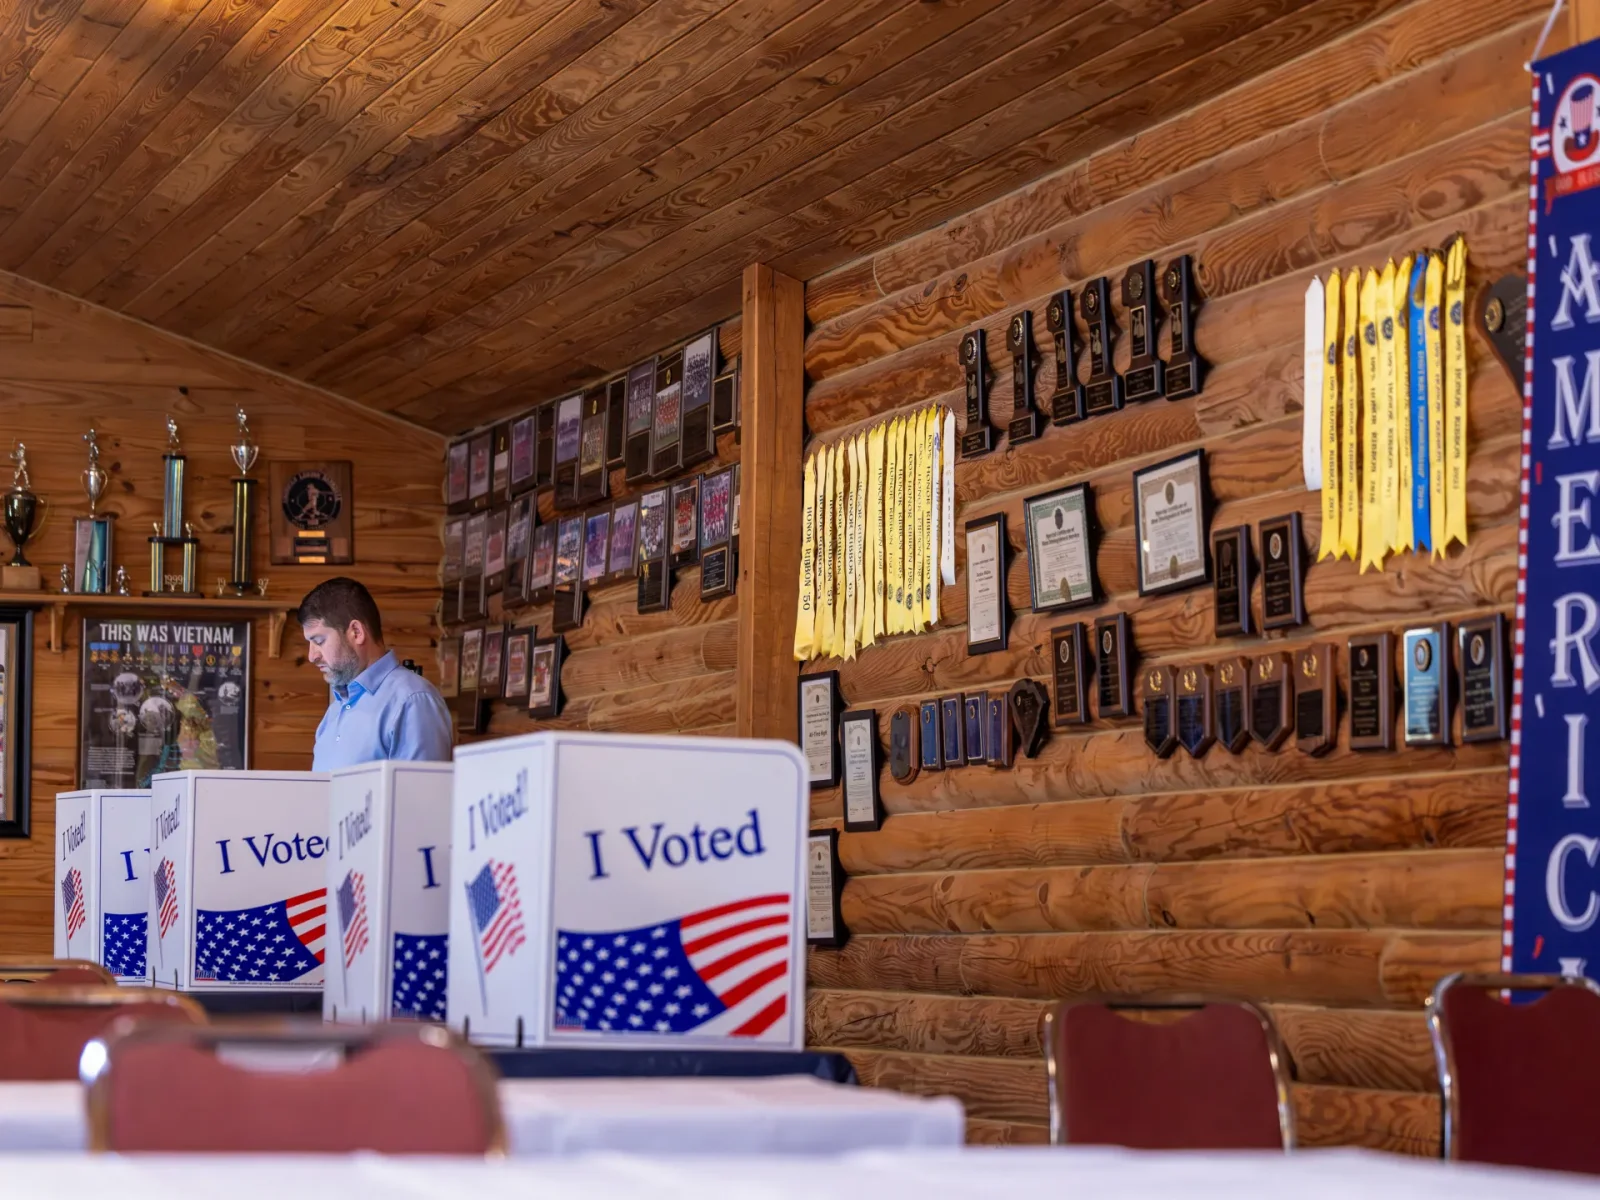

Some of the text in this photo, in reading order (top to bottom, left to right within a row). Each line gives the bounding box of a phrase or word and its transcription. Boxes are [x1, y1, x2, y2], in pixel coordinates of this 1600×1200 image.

[164, 574, 182, 585] 1999
[1546, 233, 1600, 977] AMERIC
[100, 623, 234, 644] THIS WAS VIETNAM
[66, 810, 86, 852] Voted!
[160, 793, 181, 841] Voted!
[344, 790, 372, 849] Voted!
[468, 768, 529, 851] I Voted!
[120, 849, 139, 882] I
[216, 839, 235, 874] I
[584, 808, 766, 881] I Voted
[418, 846, 441, 889] I
